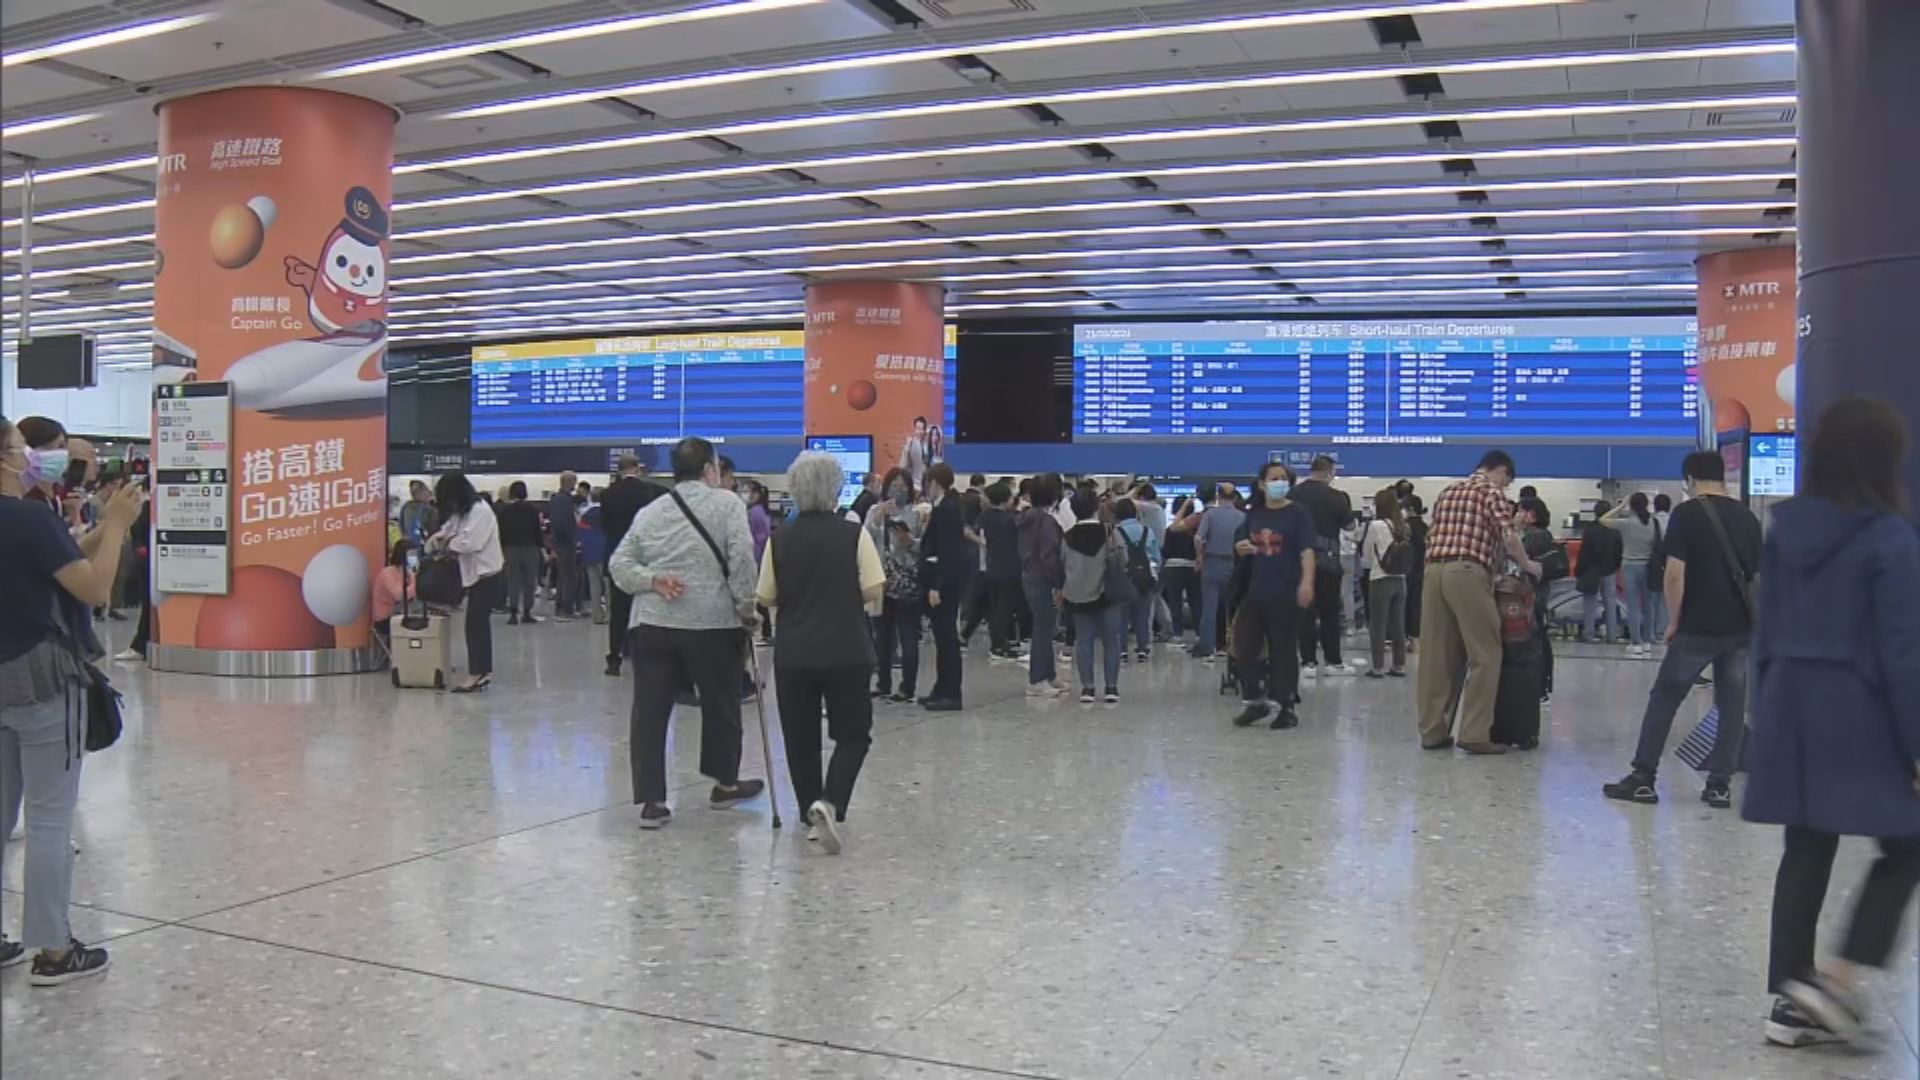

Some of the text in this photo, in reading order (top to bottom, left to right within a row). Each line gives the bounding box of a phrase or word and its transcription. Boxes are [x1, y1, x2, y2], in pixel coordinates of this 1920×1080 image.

[1739, 282, 1780, 297] MTR
[231, 316, 304, 332] Captain Go
[1349, 323, 1411, 337] Short-haul
[1415, 323, 1446, 336] Train
[1448, 323, 1515, 337] Departures
[242, 438, 345, 487] 搭高鐵
[241, 532, 262, 545] Go
[267, 519, 317, 541] Faster!
[323, 518, 343, 531] Go
